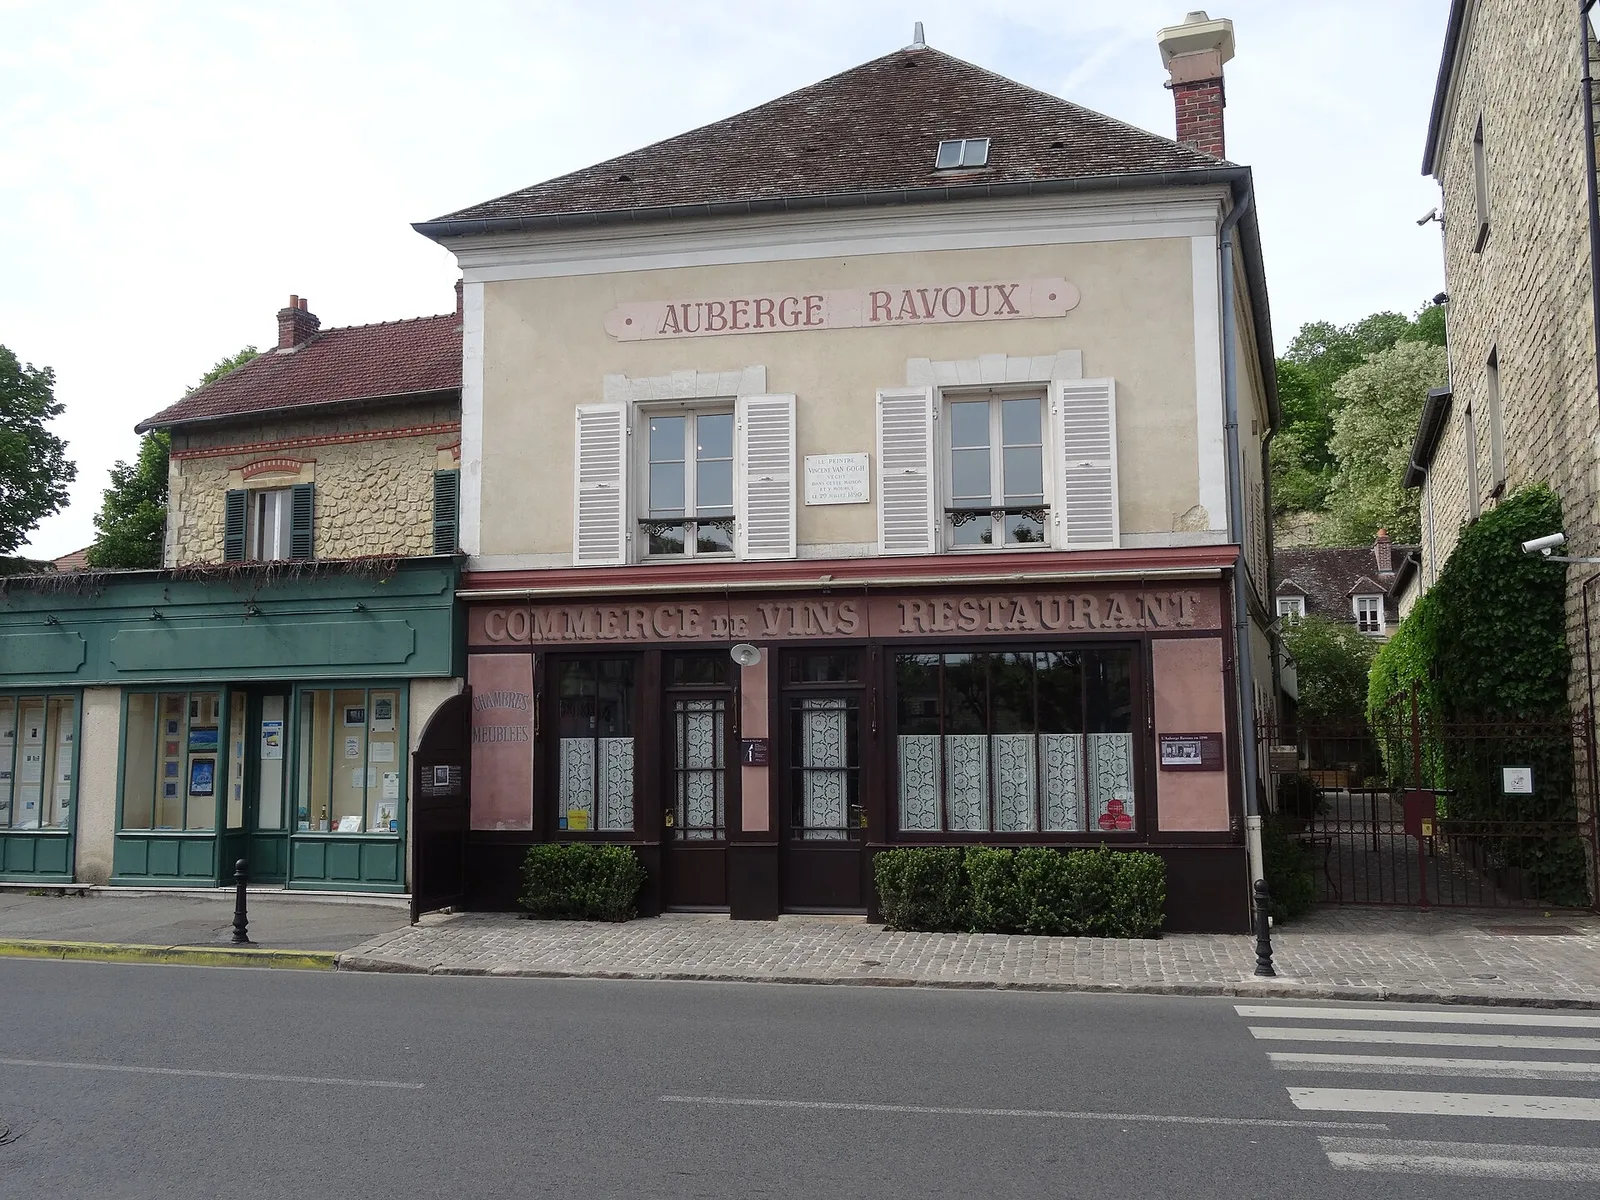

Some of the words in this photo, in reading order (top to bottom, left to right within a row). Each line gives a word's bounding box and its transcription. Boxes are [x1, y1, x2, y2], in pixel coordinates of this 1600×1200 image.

[658, 295, 824, 335] AUBERGE
[869, 284, 1020, 323] RAVOUX
[484, 604, 704, 641] COMMERCE
[759, 600, 861, 637] VINS
[898, 591, 1201, 634] RESTAURANT
[473, 690, 530, 711] CHAMBRES
